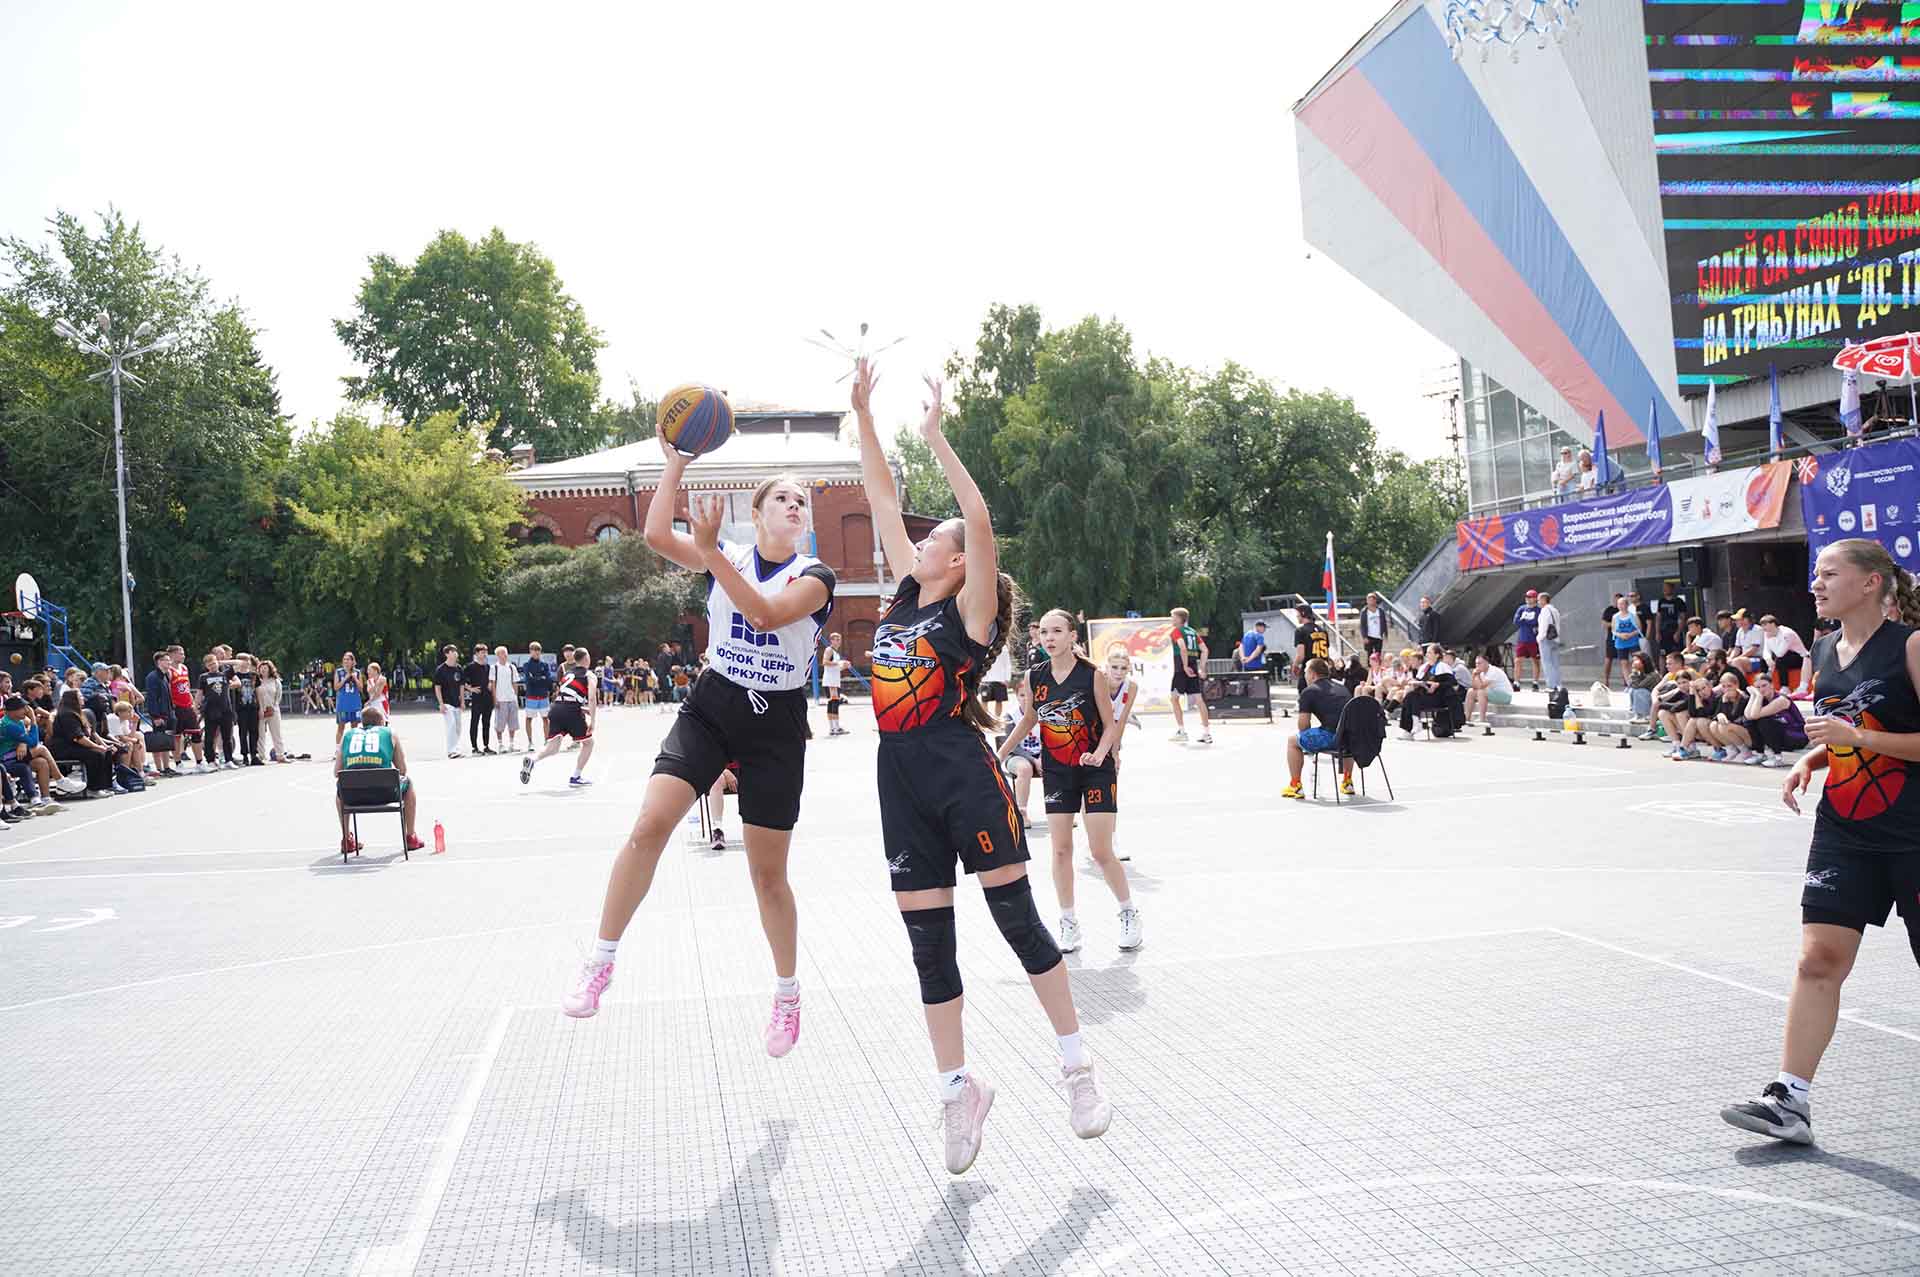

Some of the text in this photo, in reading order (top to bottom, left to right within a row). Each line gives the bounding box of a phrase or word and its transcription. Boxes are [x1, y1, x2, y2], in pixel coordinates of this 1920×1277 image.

[1762, 229, 1789, 287] ЗА
[1866, 179, 1920, 250] КОМ
[1703, 312, 1728, 367] НА
[1731, 274, 1841, 356] ТРИБУНАХ
[1087, 788, 1104, 804] 23
[976, 830, 994, 854] 8
